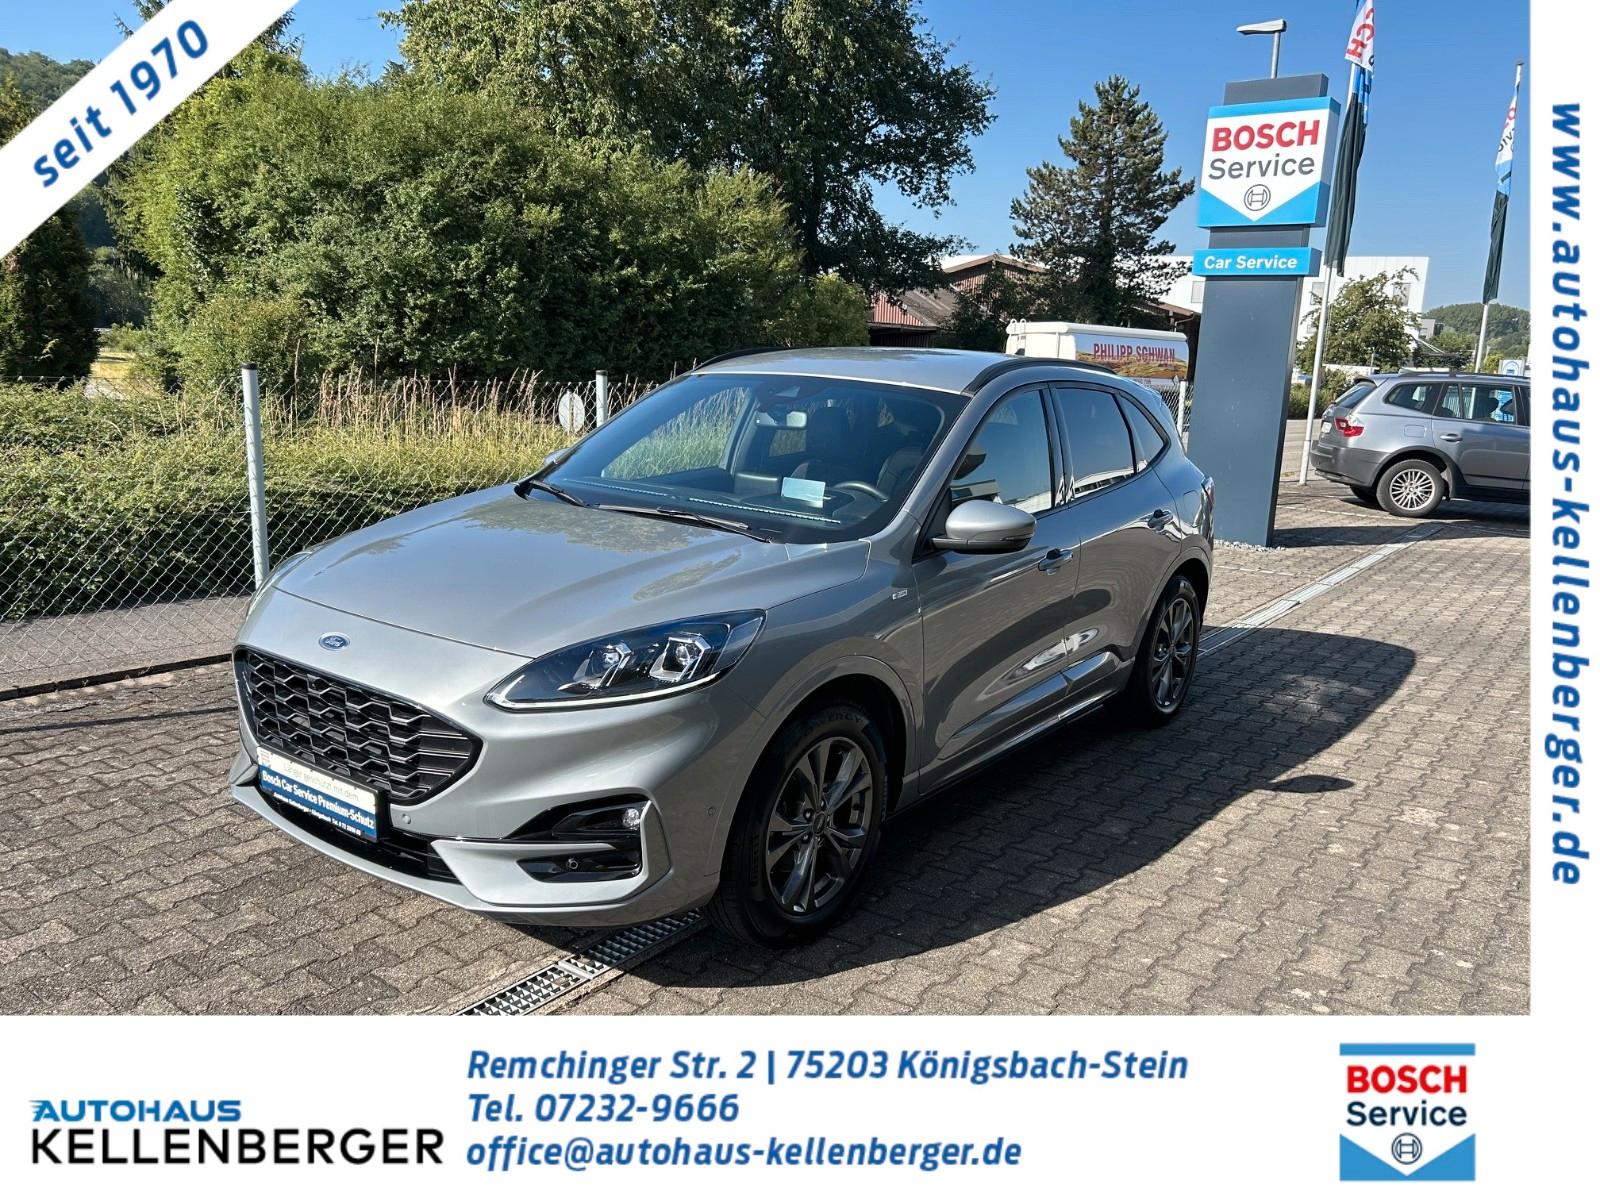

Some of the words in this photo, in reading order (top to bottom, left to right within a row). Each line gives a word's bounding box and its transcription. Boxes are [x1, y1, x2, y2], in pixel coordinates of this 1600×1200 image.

[1211, 119, 1320, 152] BOSCH
[1208, 153, 1315, 180] Service
[1203, 256, 1231, 269] Car
[1236, 254, 1298, 269] Service
[1094, 343, 1133, 360] PHILIPP
[1136, 345, 1176, 363] SCHWAN
[262, 770, 282, 788] Bosch
[281, 777, 294, 793] Car
[293, 782, 318, 805] Service
[318, 796, 375, 829] Premium-Schutz
